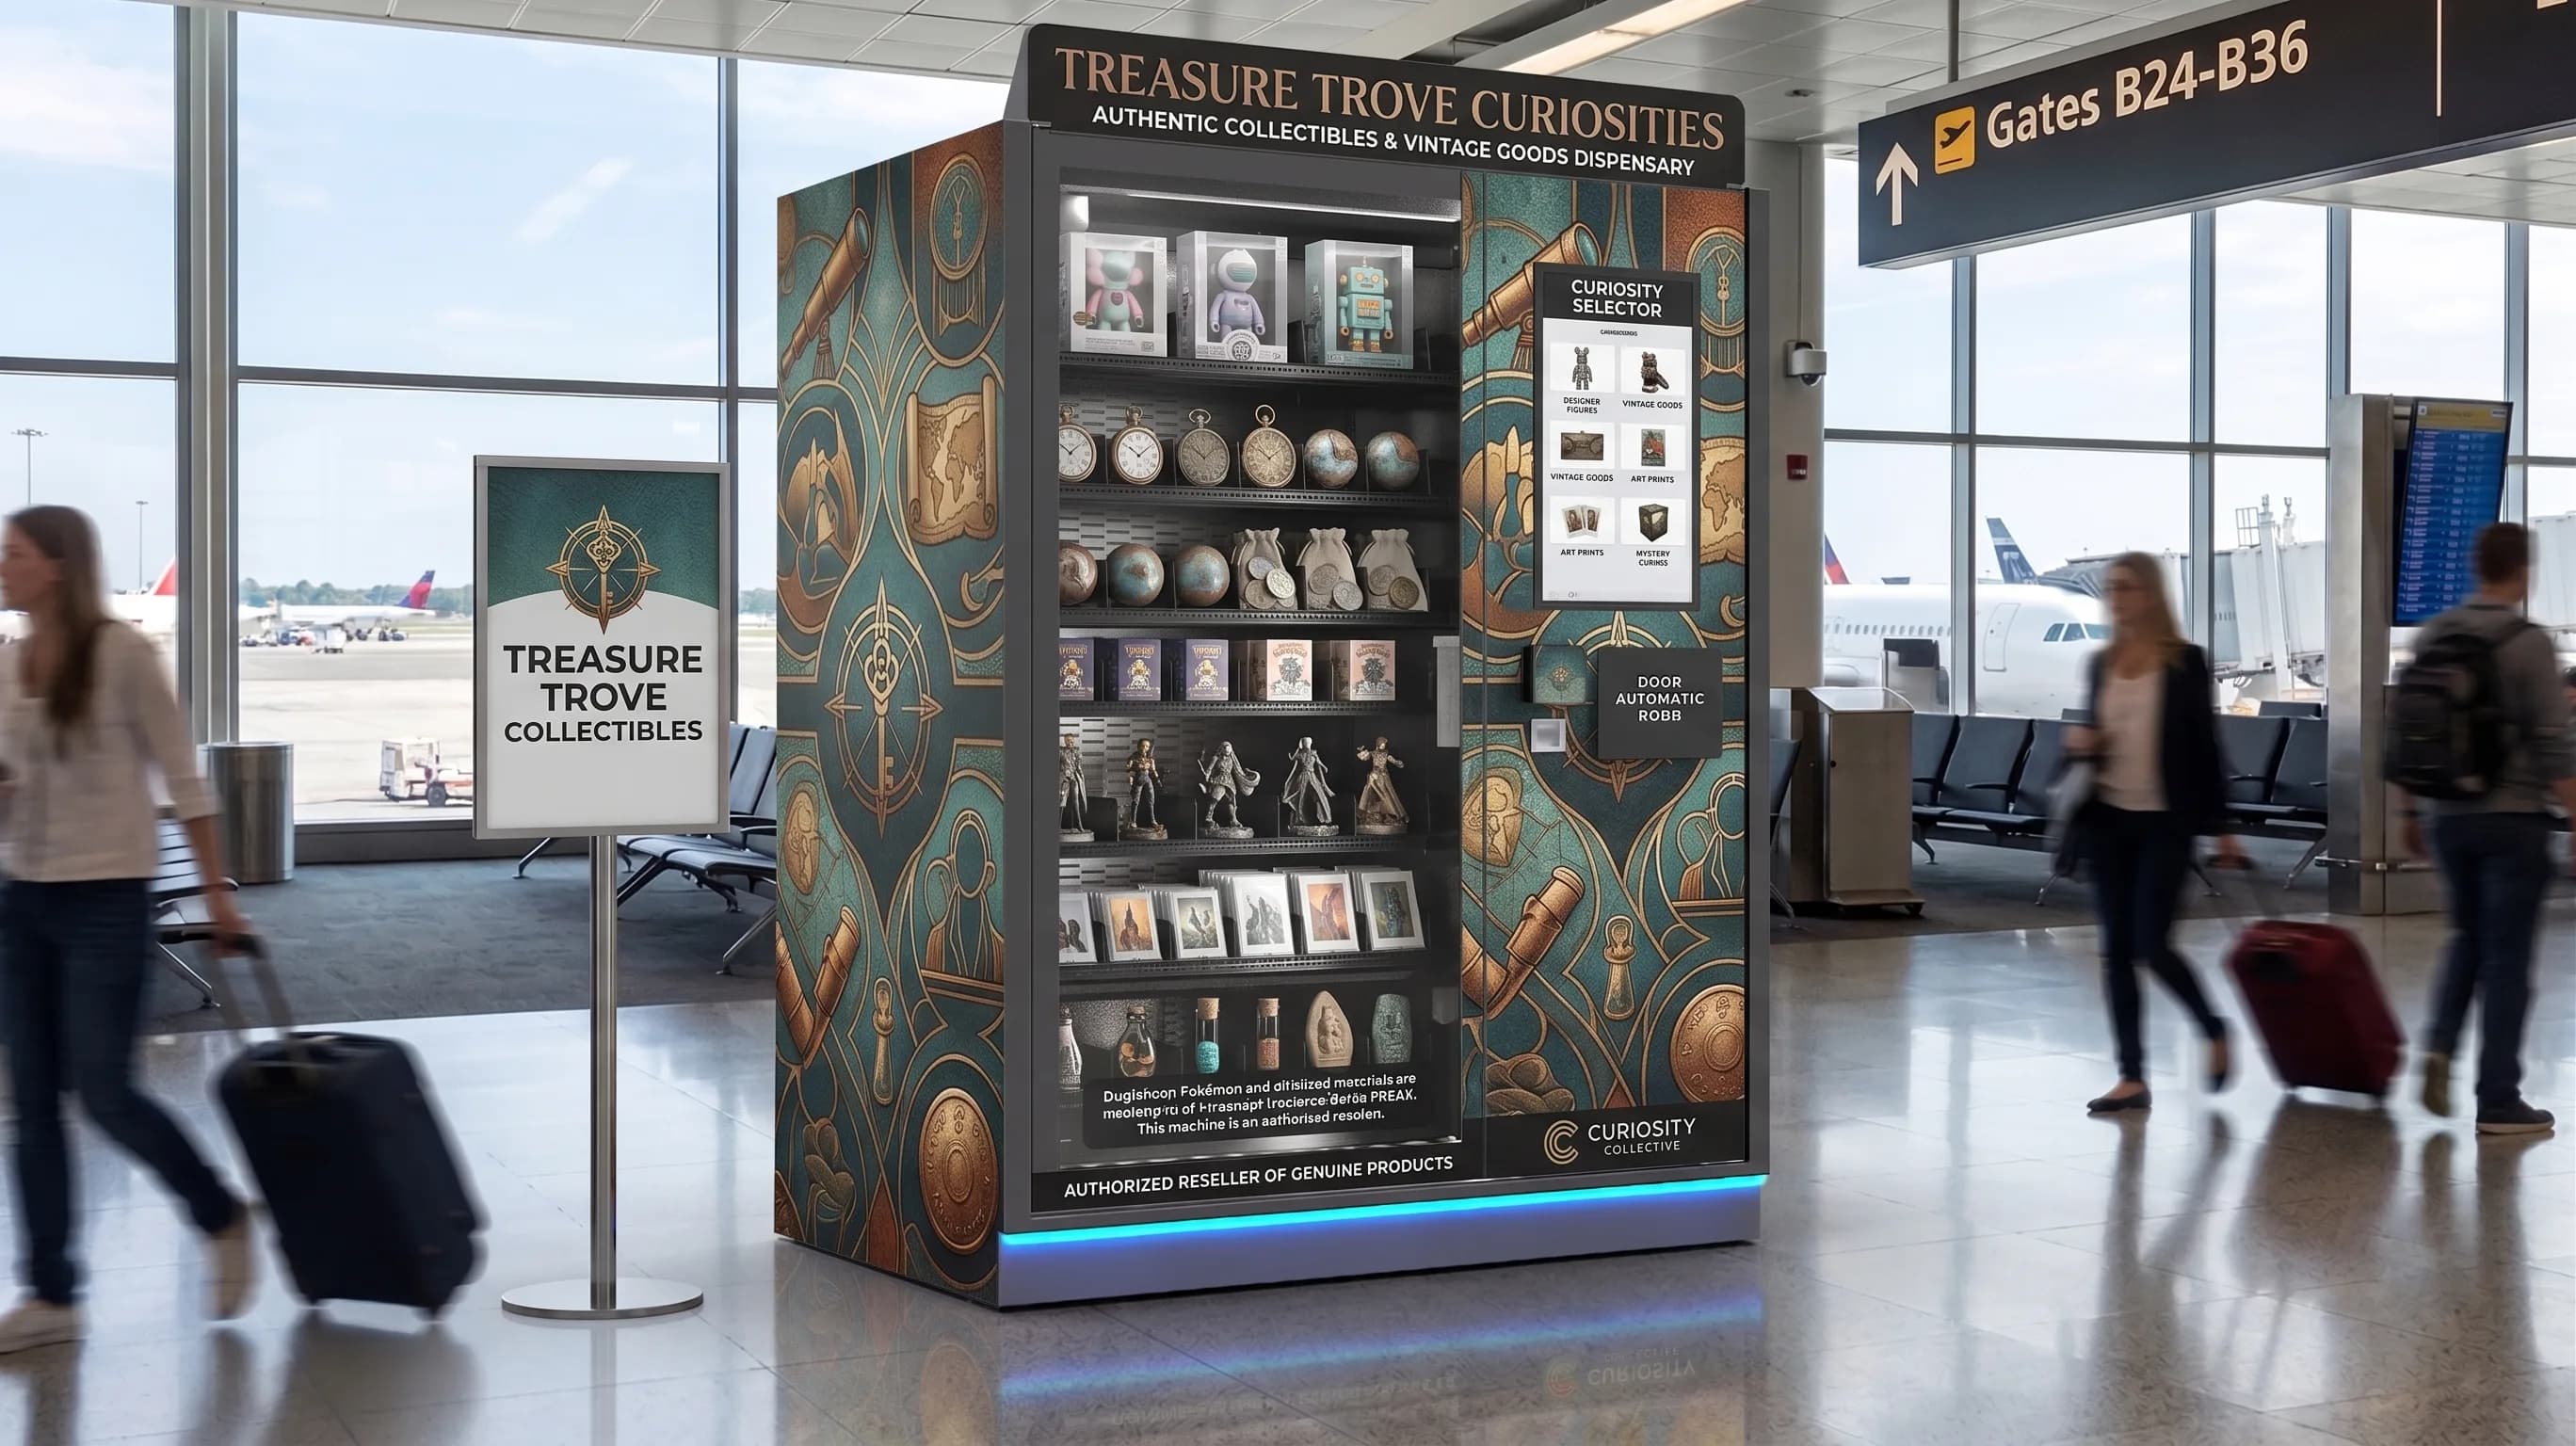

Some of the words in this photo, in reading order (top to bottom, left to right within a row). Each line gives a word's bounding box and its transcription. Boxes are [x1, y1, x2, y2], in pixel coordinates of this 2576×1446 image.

[1987, 86, 2101, 150] Gates
[2115, 20, 2310, 118] B24-B36
[1055, 47, 1298, 111] TREASURE
[1312, 73, 1457, 126] TROVE
[1471, 88, 1725, 151] CURIOSITIES
[1092, 106, 1217, 133] AUTHENTIC
[1224, 117, 1378, 148] COLLECTIBLES
[1385, 133, 1397, 149] &
[1404, 134, 1490, 158] VINTAGE
[1497, 143, 1568, 164] GOODS
[1575, 150, 1695, 175] DISPENSARY
[1570, 280, 1664, 299] CURIOSITY
[1572, 298, 1662, 317] SELECTOR
[1563, 396, 1601, 406] DESIGNER
[1567, 406, 1598, 414] FIGURES
[1622, 399, 1655, 409] VINTAGE
[1656, 400, 1683, 410] GOODS
[1550, 473, 1585, 481] VINTAGE
[1586, 474, 1614, 482] GOODS
[1631, 474, 1647, 483] ART
[1648, 475, 1675, 484] PRINTS
[504, 645, 702, 673] TREASURE
[1638, 676, 1682, 688] DOOR
[540, 683, 667, 711] TROVE
[1615, 692, 1705, 705] AUTOMATIC
[1638, 709, 1682, 722] ROBB
[505, 720, 702, 742] COLLECTIBLES
[1246, 1081, 1270, 1094] and
[1395, 1074, 1417, 1085] are
[1182, 1101, 1196, 1116] of
[1136, 1121, 1166, 1135] This
[1169, 1118, 1225, 1133] machine
[1228, 1117, 1240, 1130] is
[1242, 1118, 1259, 1129] an
[1587, 1117, 1696, 1142] CURIOSITY
[1603, 1140, 1681, 1156] COLLECTIVE
[1065, 1177, 1173, 1197] AUTHORIZED
[1180, 1170, 1259, 1189] RESELLER
[1265, 1168, 1286, 1182] OF
[1291, 1162, 1362, 1181] GENUINE
[1368, 1156, 1453, 1175] PRODUCTS
